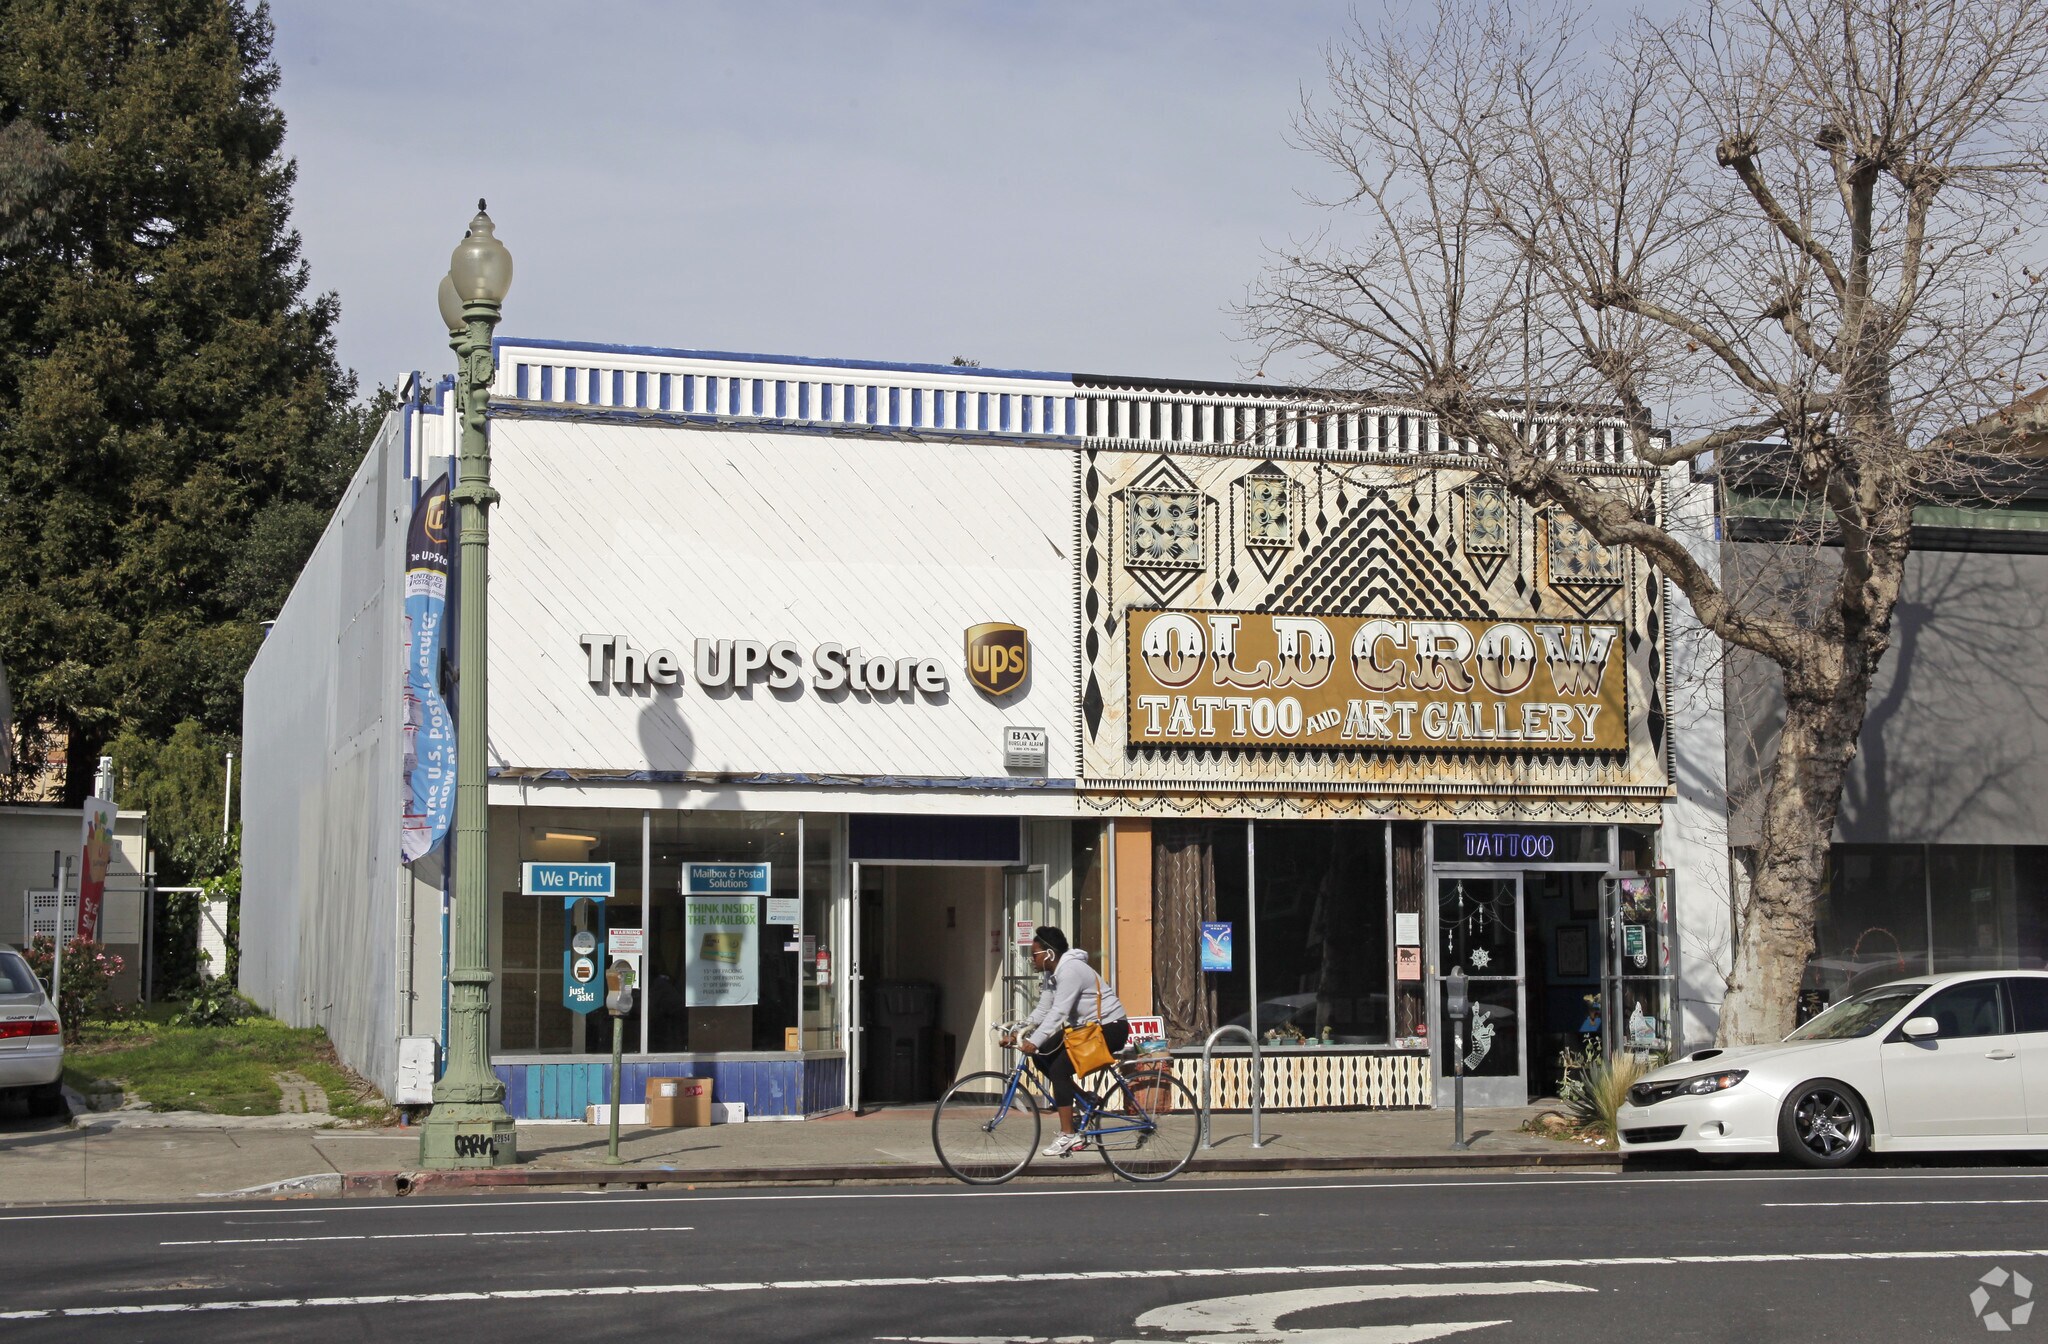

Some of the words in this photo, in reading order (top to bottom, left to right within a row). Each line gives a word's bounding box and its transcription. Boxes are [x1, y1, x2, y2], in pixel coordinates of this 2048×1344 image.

[972, 640, 1024, 684] ups
[1141, 612, 1335, 690] OLD
[1350, 619, 1617, 697] CROW
[580, 633, 679, 685] The
[694, 638, 799, 690] UPS
[813, 641, 946, 693] Store
[1137, 696, 1301, 739] TATTOO
[1306, 708, 1341, 737] AND
[1341, 698, 1420, 741] ART
[1421, 702, 1601, 743] GALLERY
[1013, 732, 1040, 740] BAY
[428, 745, 443, 779] U.S.
[427, 785, 439, 817] The
[1464, 833, 1554, 858] TATTOO
[539, 871, 564, 886] We
[568, 871, 603, 887] Print
[693, 869, 727, 878] Mailbox
[729, 869, 737, 878] &
[738, 869, 764, 878] Postal
[709, 879, 748, 888] Solutions
[688, 904, 719, 914] THINK
[722, 904, 755, 914] INSIDE
[688, 915, 706, 925] THE
[709, 915, 756, 925] MAILBOX
[569, 987, 585, 997] just
[576, 993, 594, 1002] ask!
